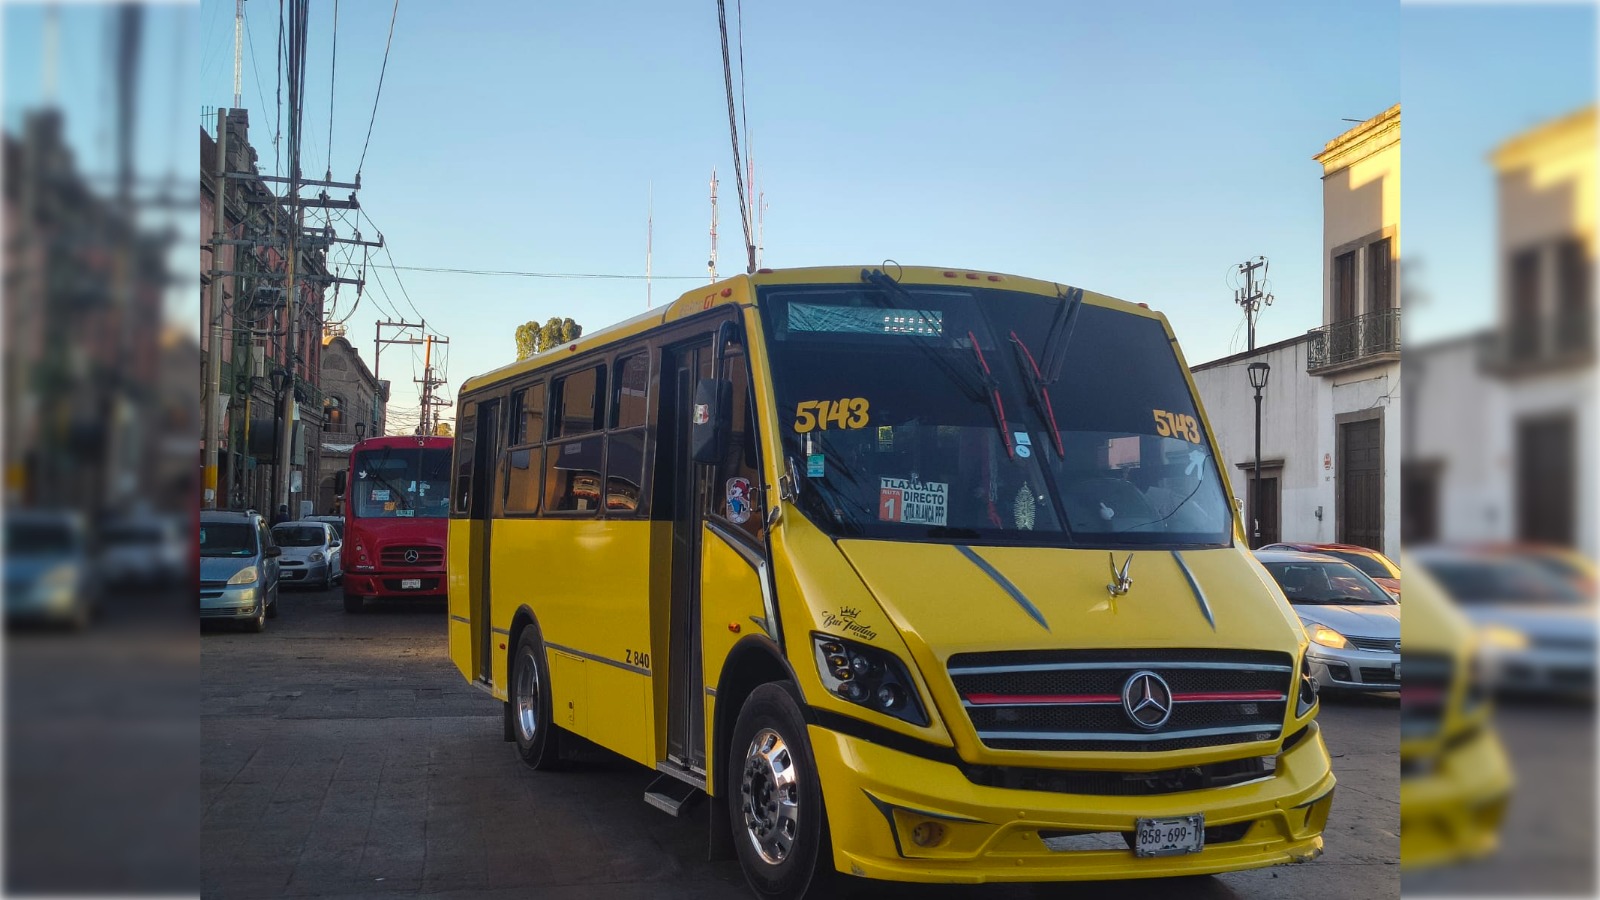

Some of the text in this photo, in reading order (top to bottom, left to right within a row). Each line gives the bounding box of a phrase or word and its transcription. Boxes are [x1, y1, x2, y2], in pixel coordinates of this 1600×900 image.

[794, 397, 869, 433] 5143
[1153, 409, 1200, 444] 5143
[882, 479, 944, 493] TLAXCALA
[884, 498, 895, 519] 1
[903, 491, 944, 505] DIRECTO
[842, 617, 877, 640] Tuning
[625, 649, 650, 669] Z 840
